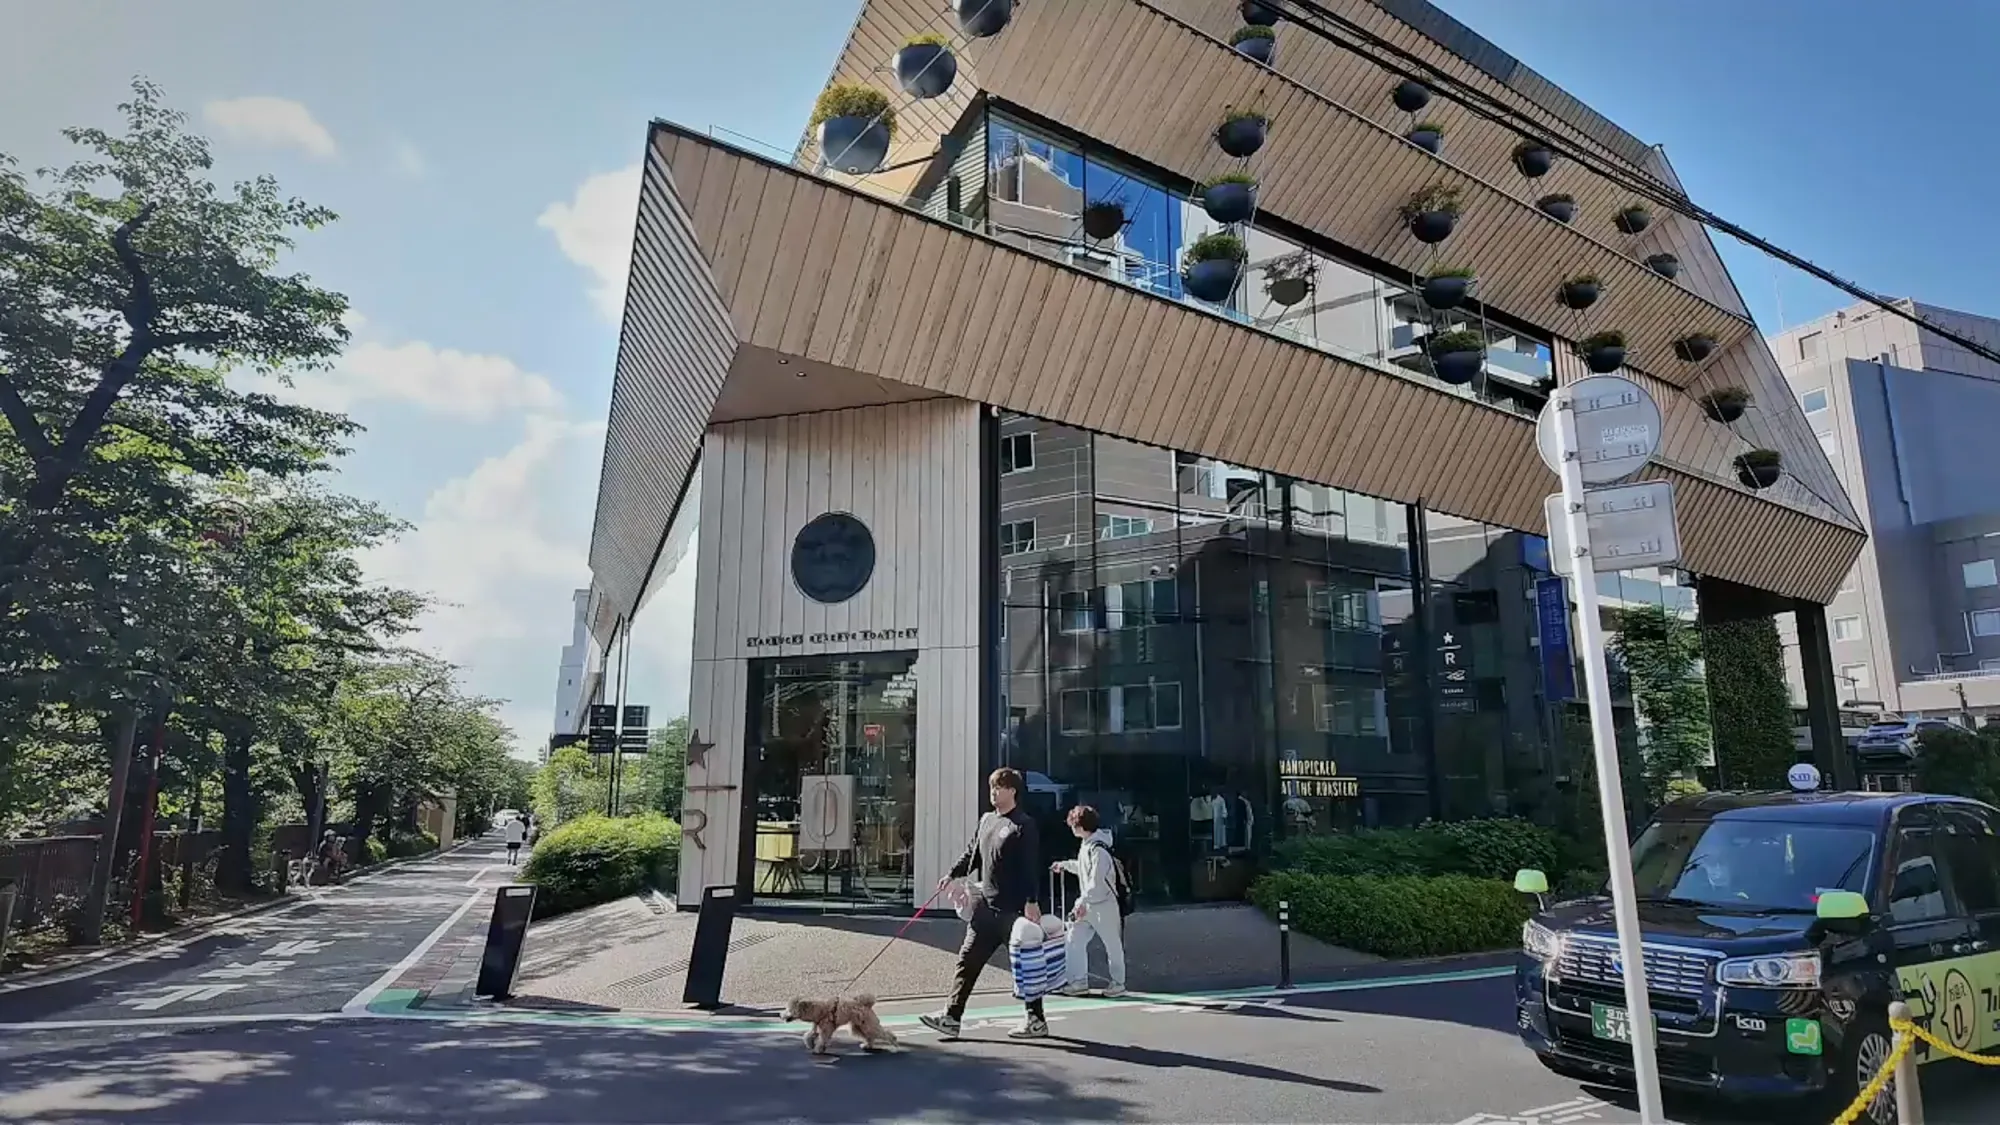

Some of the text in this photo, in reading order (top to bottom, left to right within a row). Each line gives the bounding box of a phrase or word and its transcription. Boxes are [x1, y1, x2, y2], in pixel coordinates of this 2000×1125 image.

[746, 634, 804, 647] STARBUCKS
[809, 632, 857, 644] RESERVE
[1445, 652, 1456, 665] R
[1279, 760, 1337, 776] HANDPICKED
[1281, 780, 1358, 796] AT THE ROASTERY
